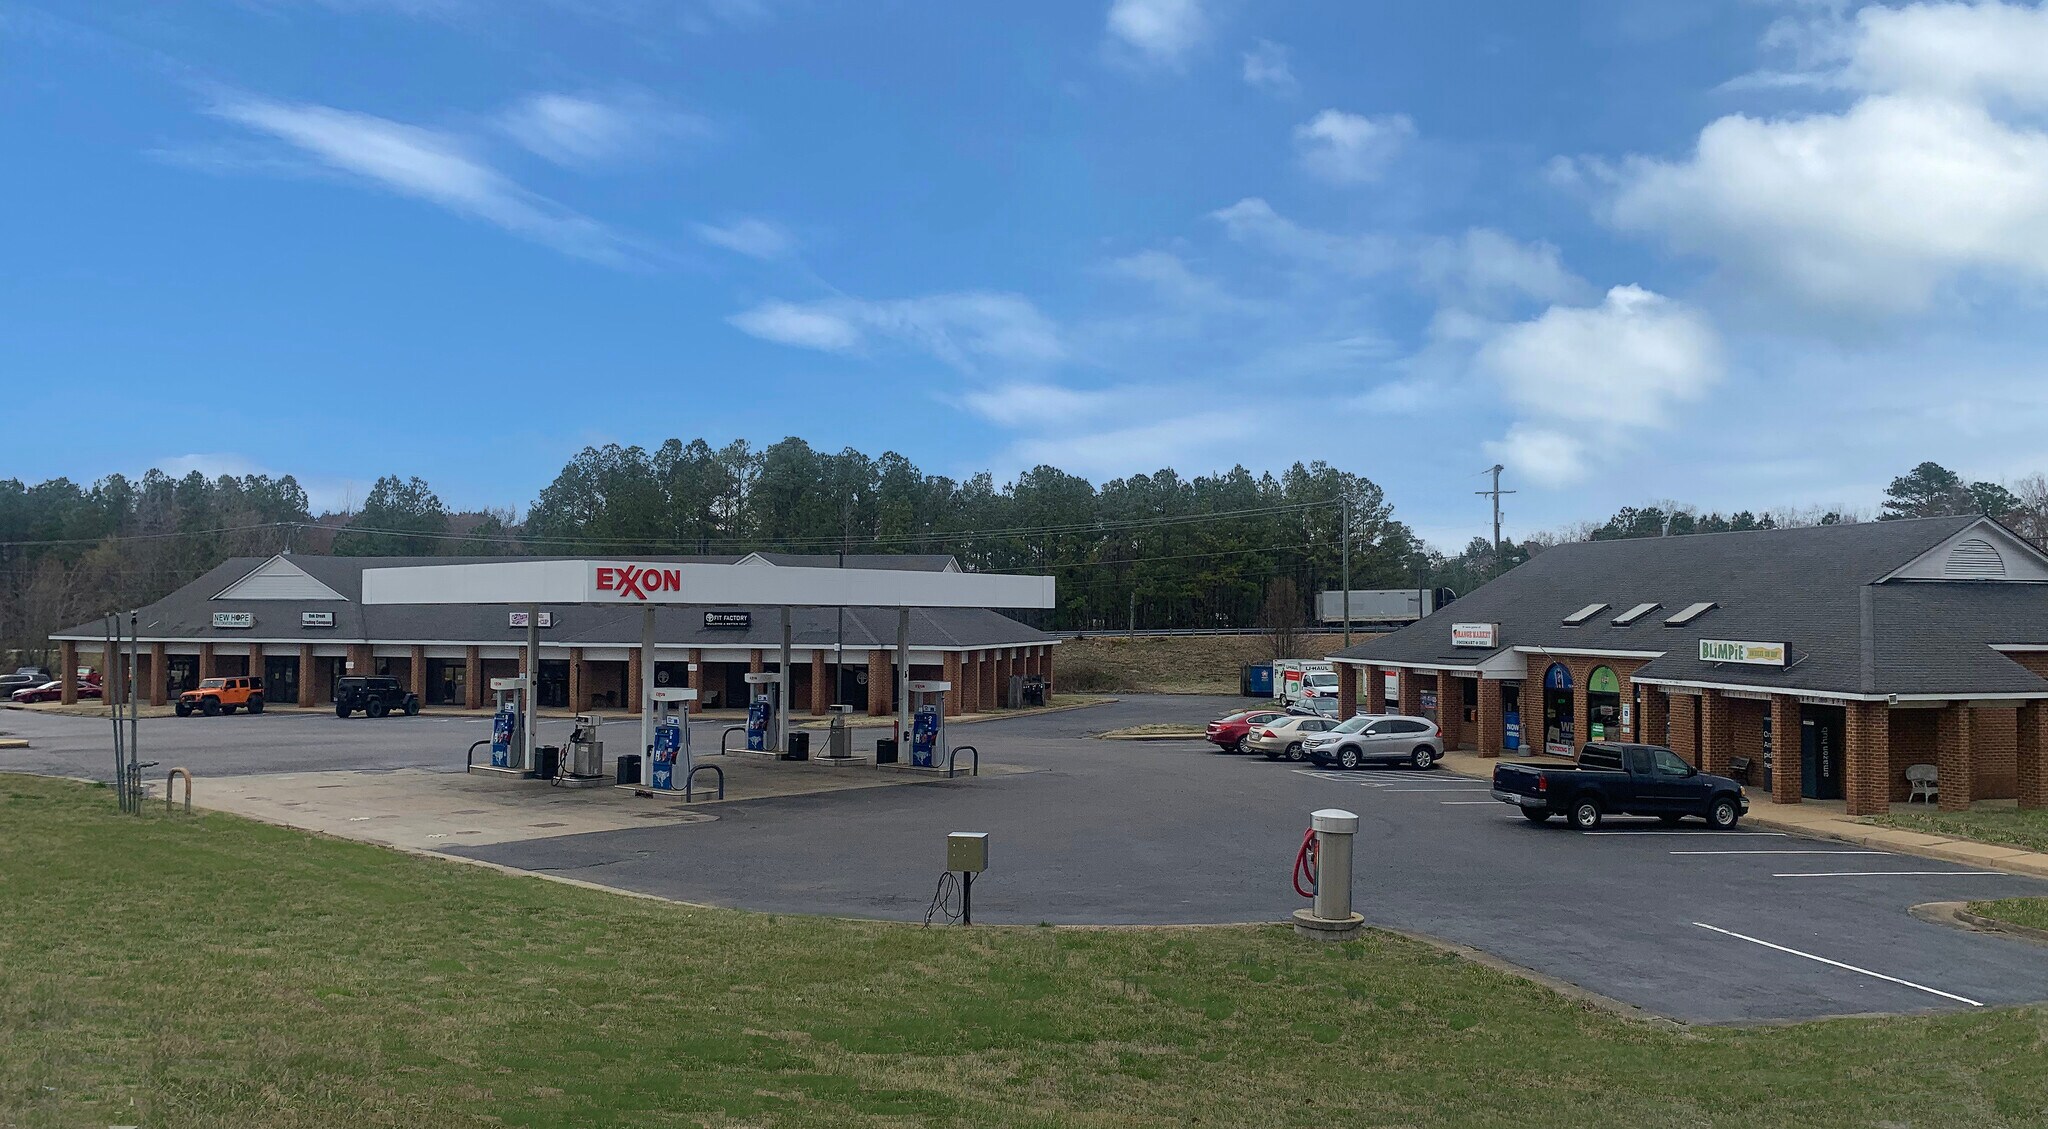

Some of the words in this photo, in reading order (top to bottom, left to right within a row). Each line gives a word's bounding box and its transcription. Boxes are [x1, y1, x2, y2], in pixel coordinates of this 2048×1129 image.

[596, 565, 681, 600] EXXON
[214, 613, 229, 621] NEW
[231, 613, 249, 622] HOPE
[1506, 723, 1520, 731] NOW
[1561, 722, 1574, 732] WE
